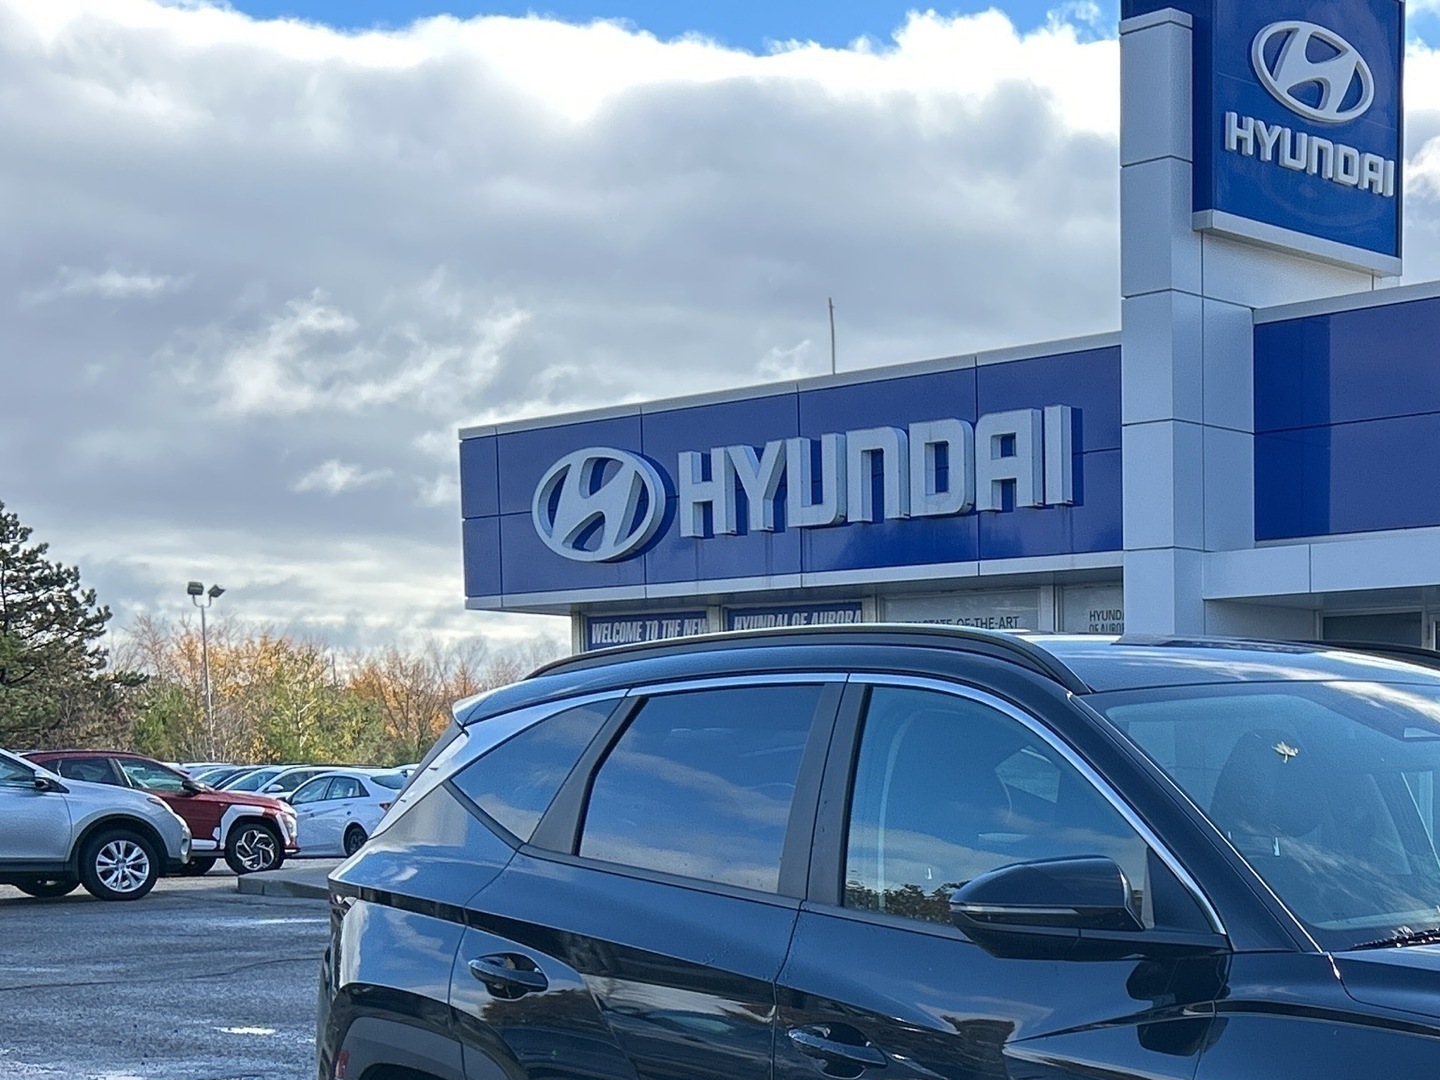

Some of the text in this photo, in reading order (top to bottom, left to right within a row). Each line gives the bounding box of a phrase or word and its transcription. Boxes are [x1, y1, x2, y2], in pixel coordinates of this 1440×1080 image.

[1224, 110, 1395, 198] HYUNDAI
[677, 404, 1074, 539] HYUNDAI
[591, 620, 642, 645] WELCOME
[645, 620, 659, 641] TO
[661, 618, 681, 639] THE
[1089, 609, 1124, 622] HYUND
